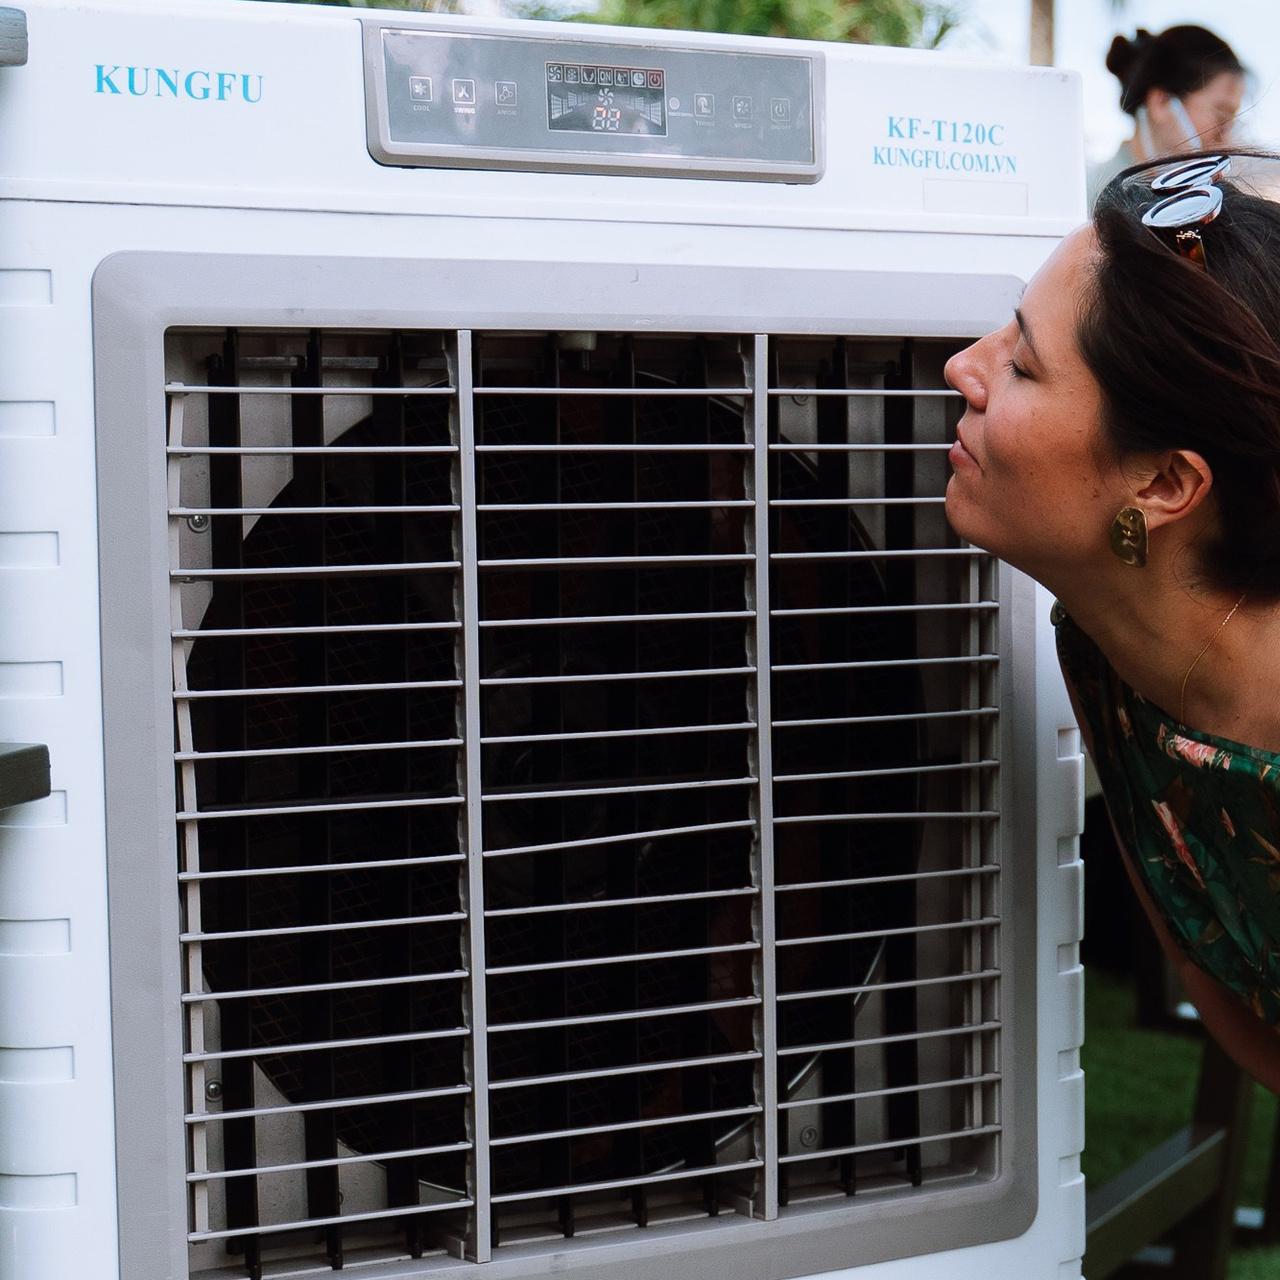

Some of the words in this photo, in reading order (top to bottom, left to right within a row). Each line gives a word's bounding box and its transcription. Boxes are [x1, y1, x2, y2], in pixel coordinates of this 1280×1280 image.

[94, 64, 265, 103] KUNGFU
[600, 71, 611, 81] ON
[888, 116, 1004, 146] KF-T120C
[873, 146, 1017, 174] KUNGFU.COM.VN
